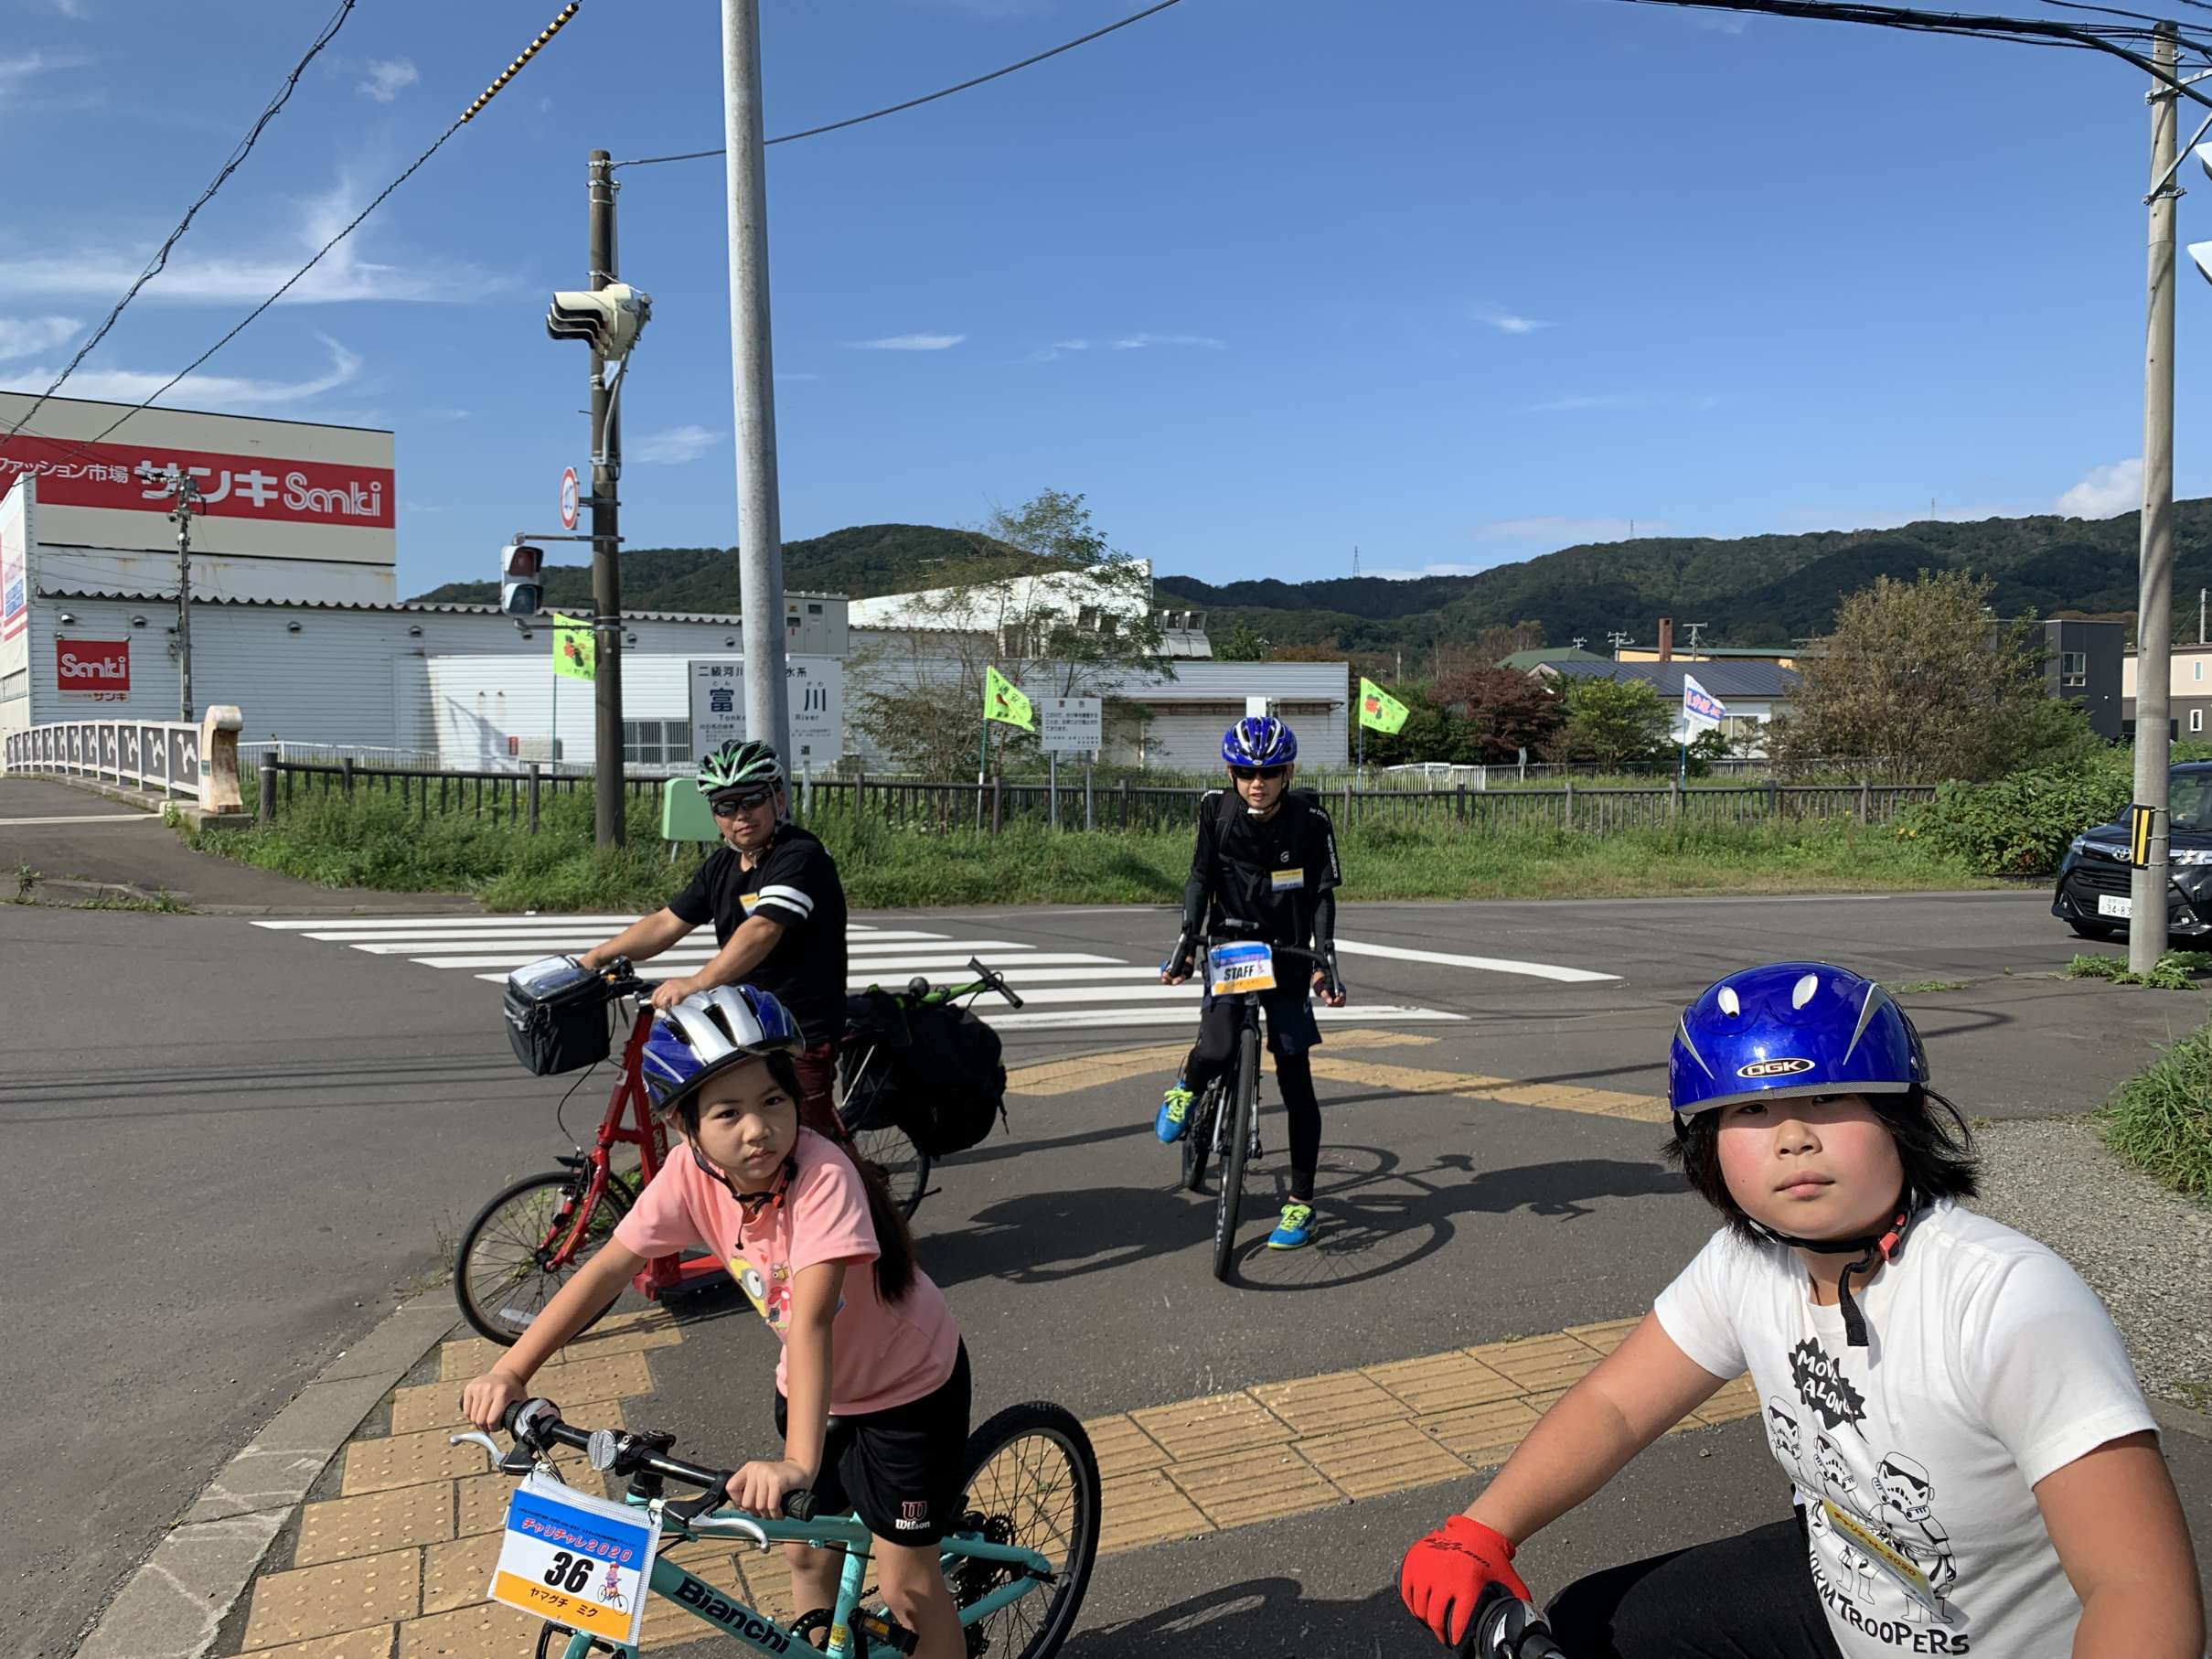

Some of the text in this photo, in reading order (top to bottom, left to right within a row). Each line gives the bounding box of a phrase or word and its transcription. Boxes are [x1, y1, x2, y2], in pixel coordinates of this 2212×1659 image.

[134, 461, 279, 508] サンキ
[283, 471, 382, 517] Sanki
[60, 653, 126, 679] Sanki
[94, 692, 127, 701] サンキ
[1224, 965, 1256, 980] STAFF
[1747, 1060, 1803, 1076] OGK
[1798, 1349, 1839, 1386] MOVE
[895, 1519, 930, 1530] Wilson
[543, 1551, 594, 1594] 36
[529, 1587, 599, 1618] ヤマグチ ミク
[672, 1576, 792, 1654] Bianchi
